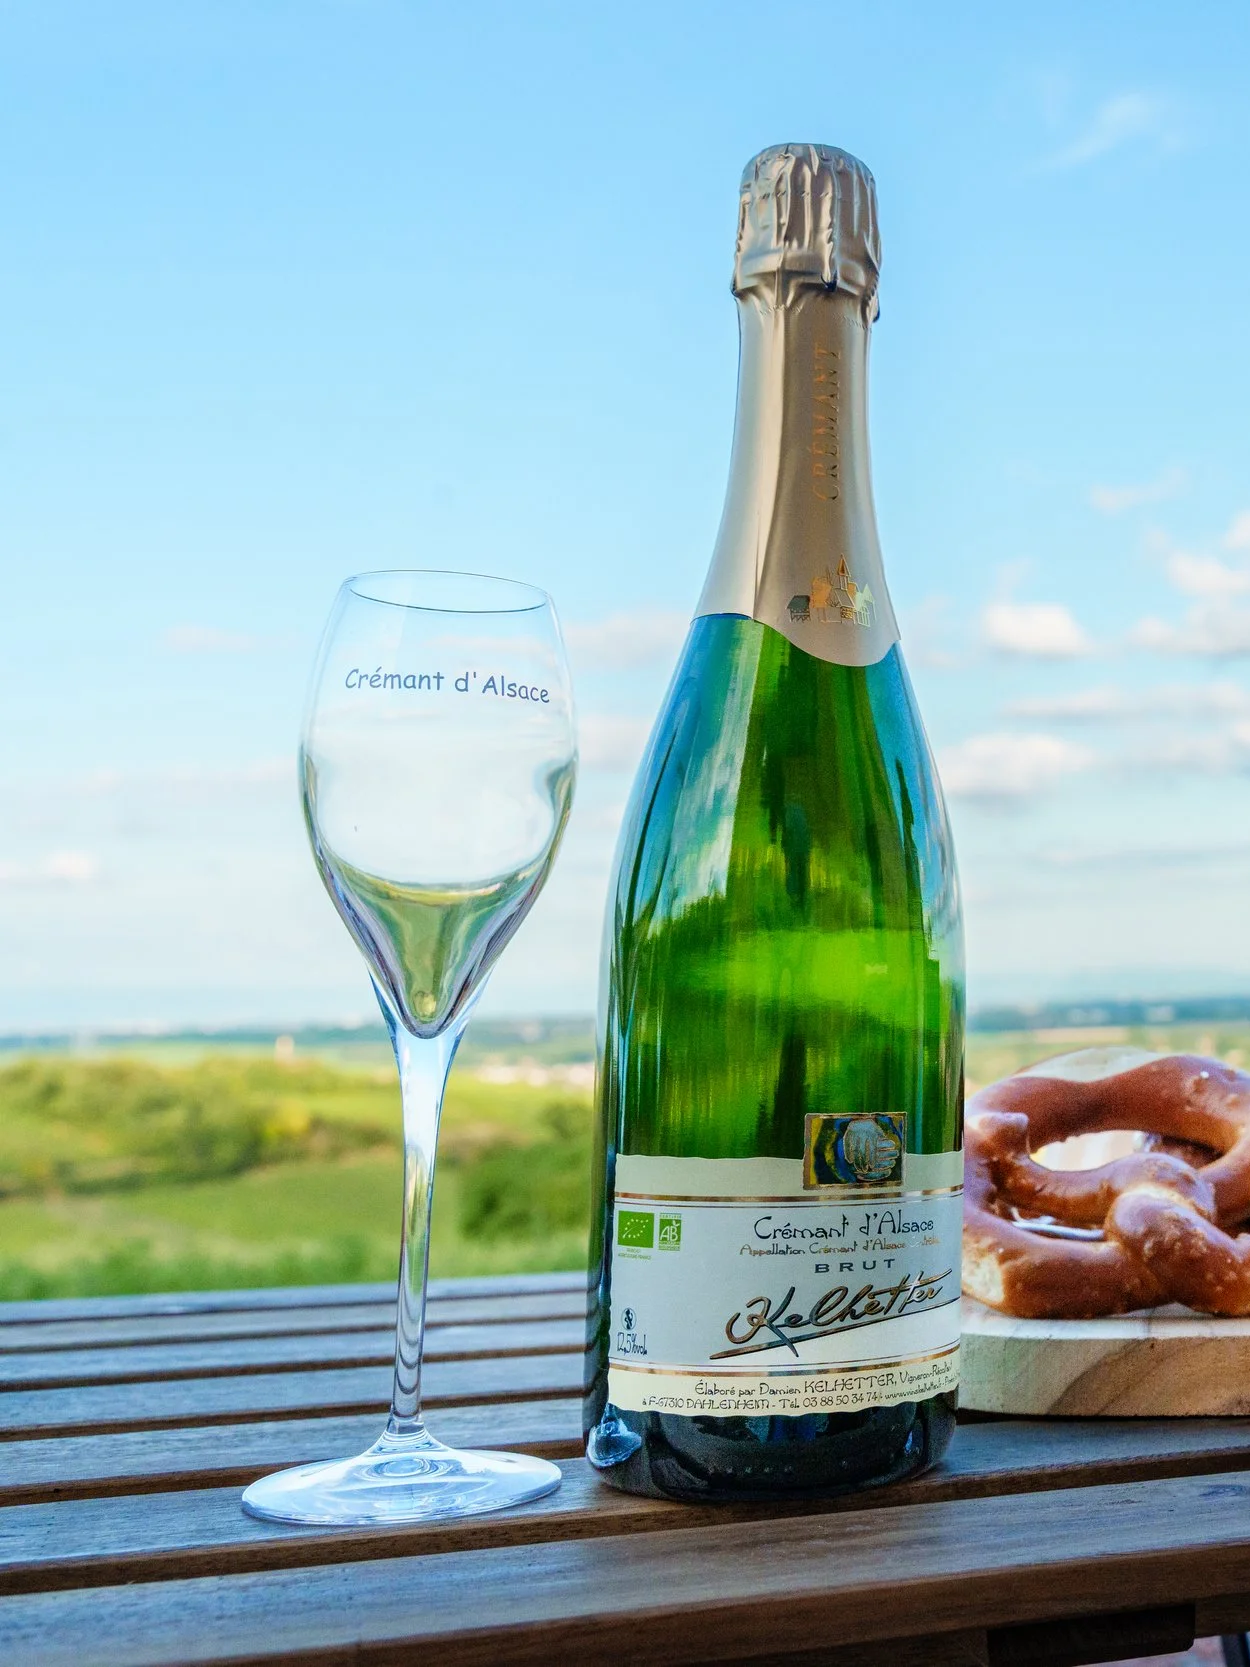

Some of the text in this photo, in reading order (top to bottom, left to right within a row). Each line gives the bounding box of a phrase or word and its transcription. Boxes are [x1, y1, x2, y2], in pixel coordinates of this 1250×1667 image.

[806, 342, 841, 502] CRÉMANT
[345, 666, 550, 704] Crémant d'Alsace
[659, 1225, 679, 1242] AB
[753, 1210, 934, 1240] Crémant d'Alsace
[739, 1243, 806, 1258] Appellation
[809, 1241, 859, 1256] Crémant
[862, 1238, 906, 1252] d'Alsace
[814, 1258, 896, 1274] BRUT
[694, 1379, 736, 1396] Élaboré
[738, 1387, 756, 1398] par
[759, 1382, 801, 1396] Damien
[803, 1372, 898, 1394] KELHETTER,
[648, 1396, 685, 1409] F-67310
[686, 1397, 770, 1410] DAHLENHEIM
[778, 1397, 800, 1409] Tél.
[802, 1397, 818, 1408] 03
[819, 1395, 834, 1407] 88
[835, 1394, 849, 1406] 50
[851, 1392, 865, 1405] 34
[866, 1391, 878, 1402] 74
